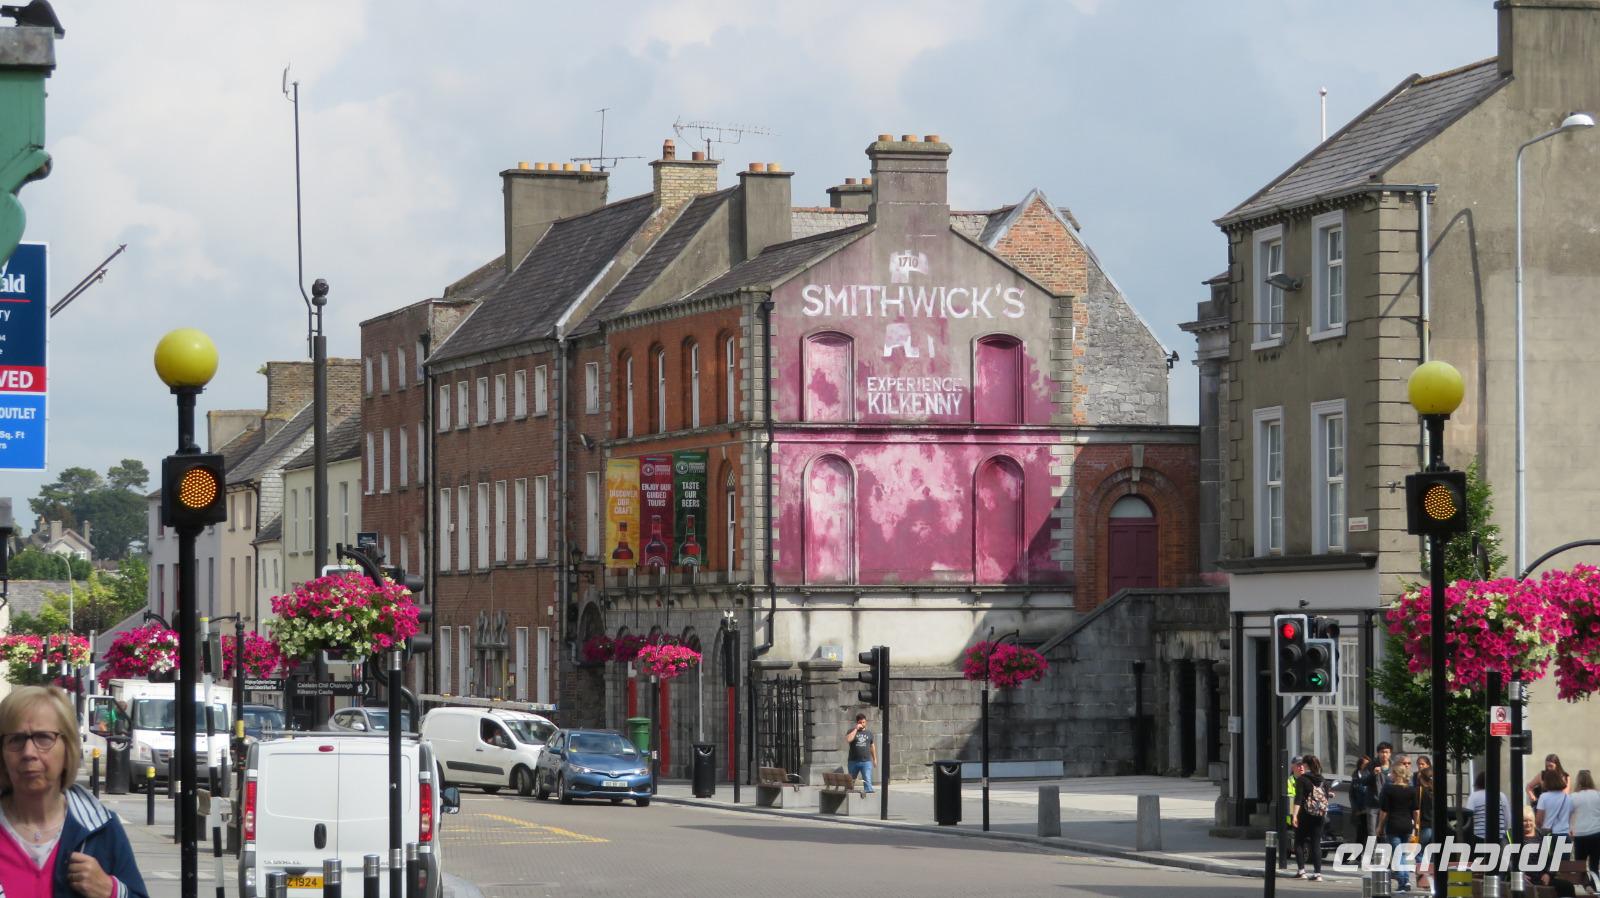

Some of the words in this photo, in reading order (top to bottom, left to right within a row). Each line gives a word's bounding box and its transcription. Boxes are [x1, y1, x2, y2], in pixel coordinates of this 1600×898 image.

[898, 257, 919, 268] 1710
[801, 283, 1025, 319] SMITHWICK'S
[867, 377, 963, 392] EXPERIENCE
[867, 392, 963, 415] KILKENNY
[641, 483, 659, 491] ENJOY
[660, 483, 672, 491] OUR
[646, 491, 667, 499] GUIDED
[684, 490, 697, 498] OUR
[617, 498, 630, 506] OUR
[648, 499, 666, 507] TOURS
[682, 499, 700, 507] BEERS
